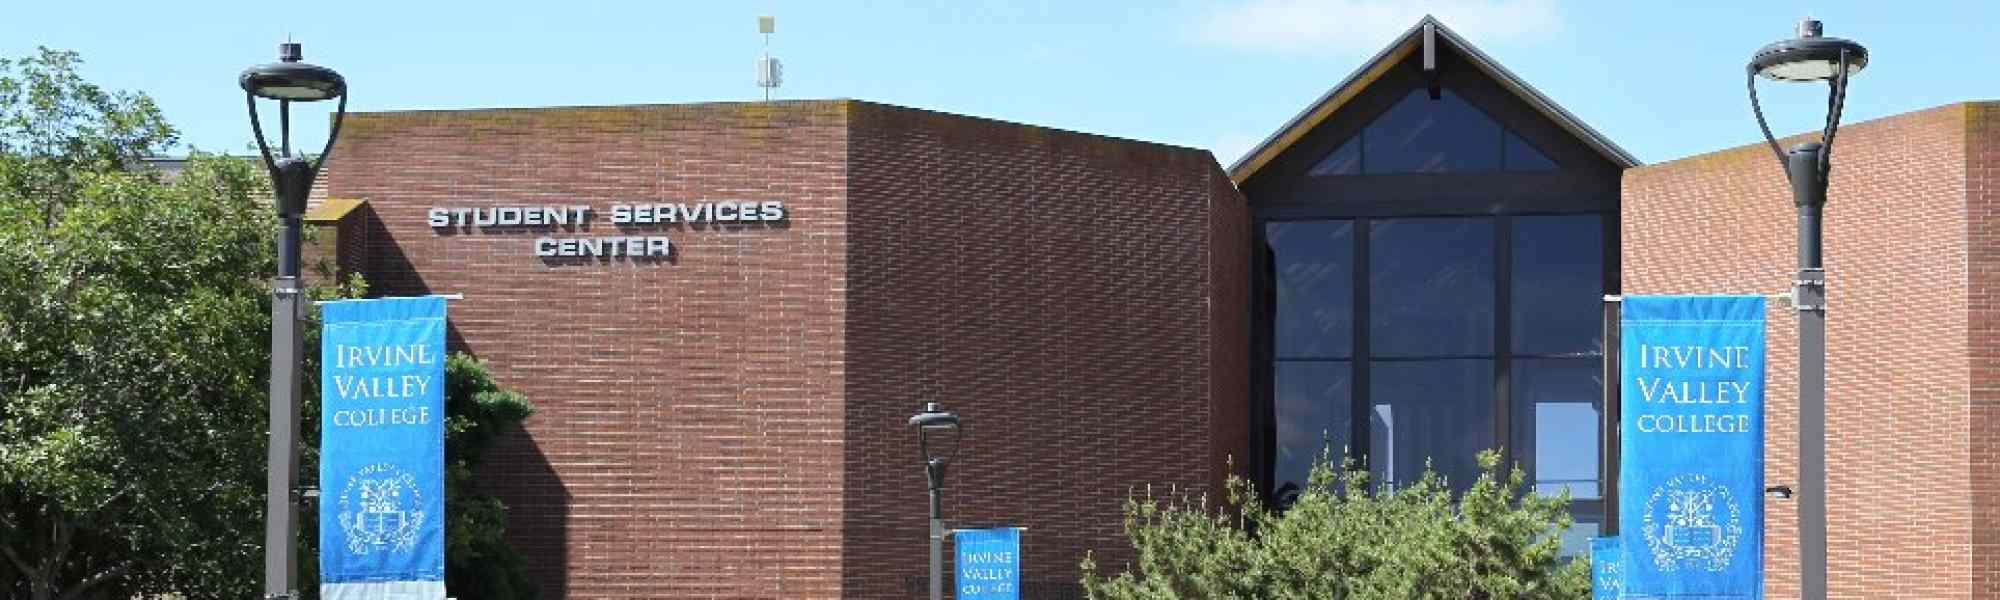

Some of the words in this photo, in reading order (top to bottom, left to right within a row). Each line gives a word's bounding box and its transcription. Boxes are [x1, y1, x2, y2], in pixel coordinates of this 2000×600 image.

[428, 205, 592, 228] STUDENT
[610, 201, 785, 224] SERVICES
[535, 236, 671, 257] CENTER
[335, 343, 434, 369] IRVINE
[1640, 343, 1749, 369] IRVINE
[333, 375, 431, 400] VALLEY
[1636, 377, 1751, 404] VALLEY
[333, 405, 430, 427] COLLEGE
[1637, 414, 1750, 433] COLLEGE
[961, 568, 1013, 581] VALLEY
[962, 582, 1013, 595] COEGE
